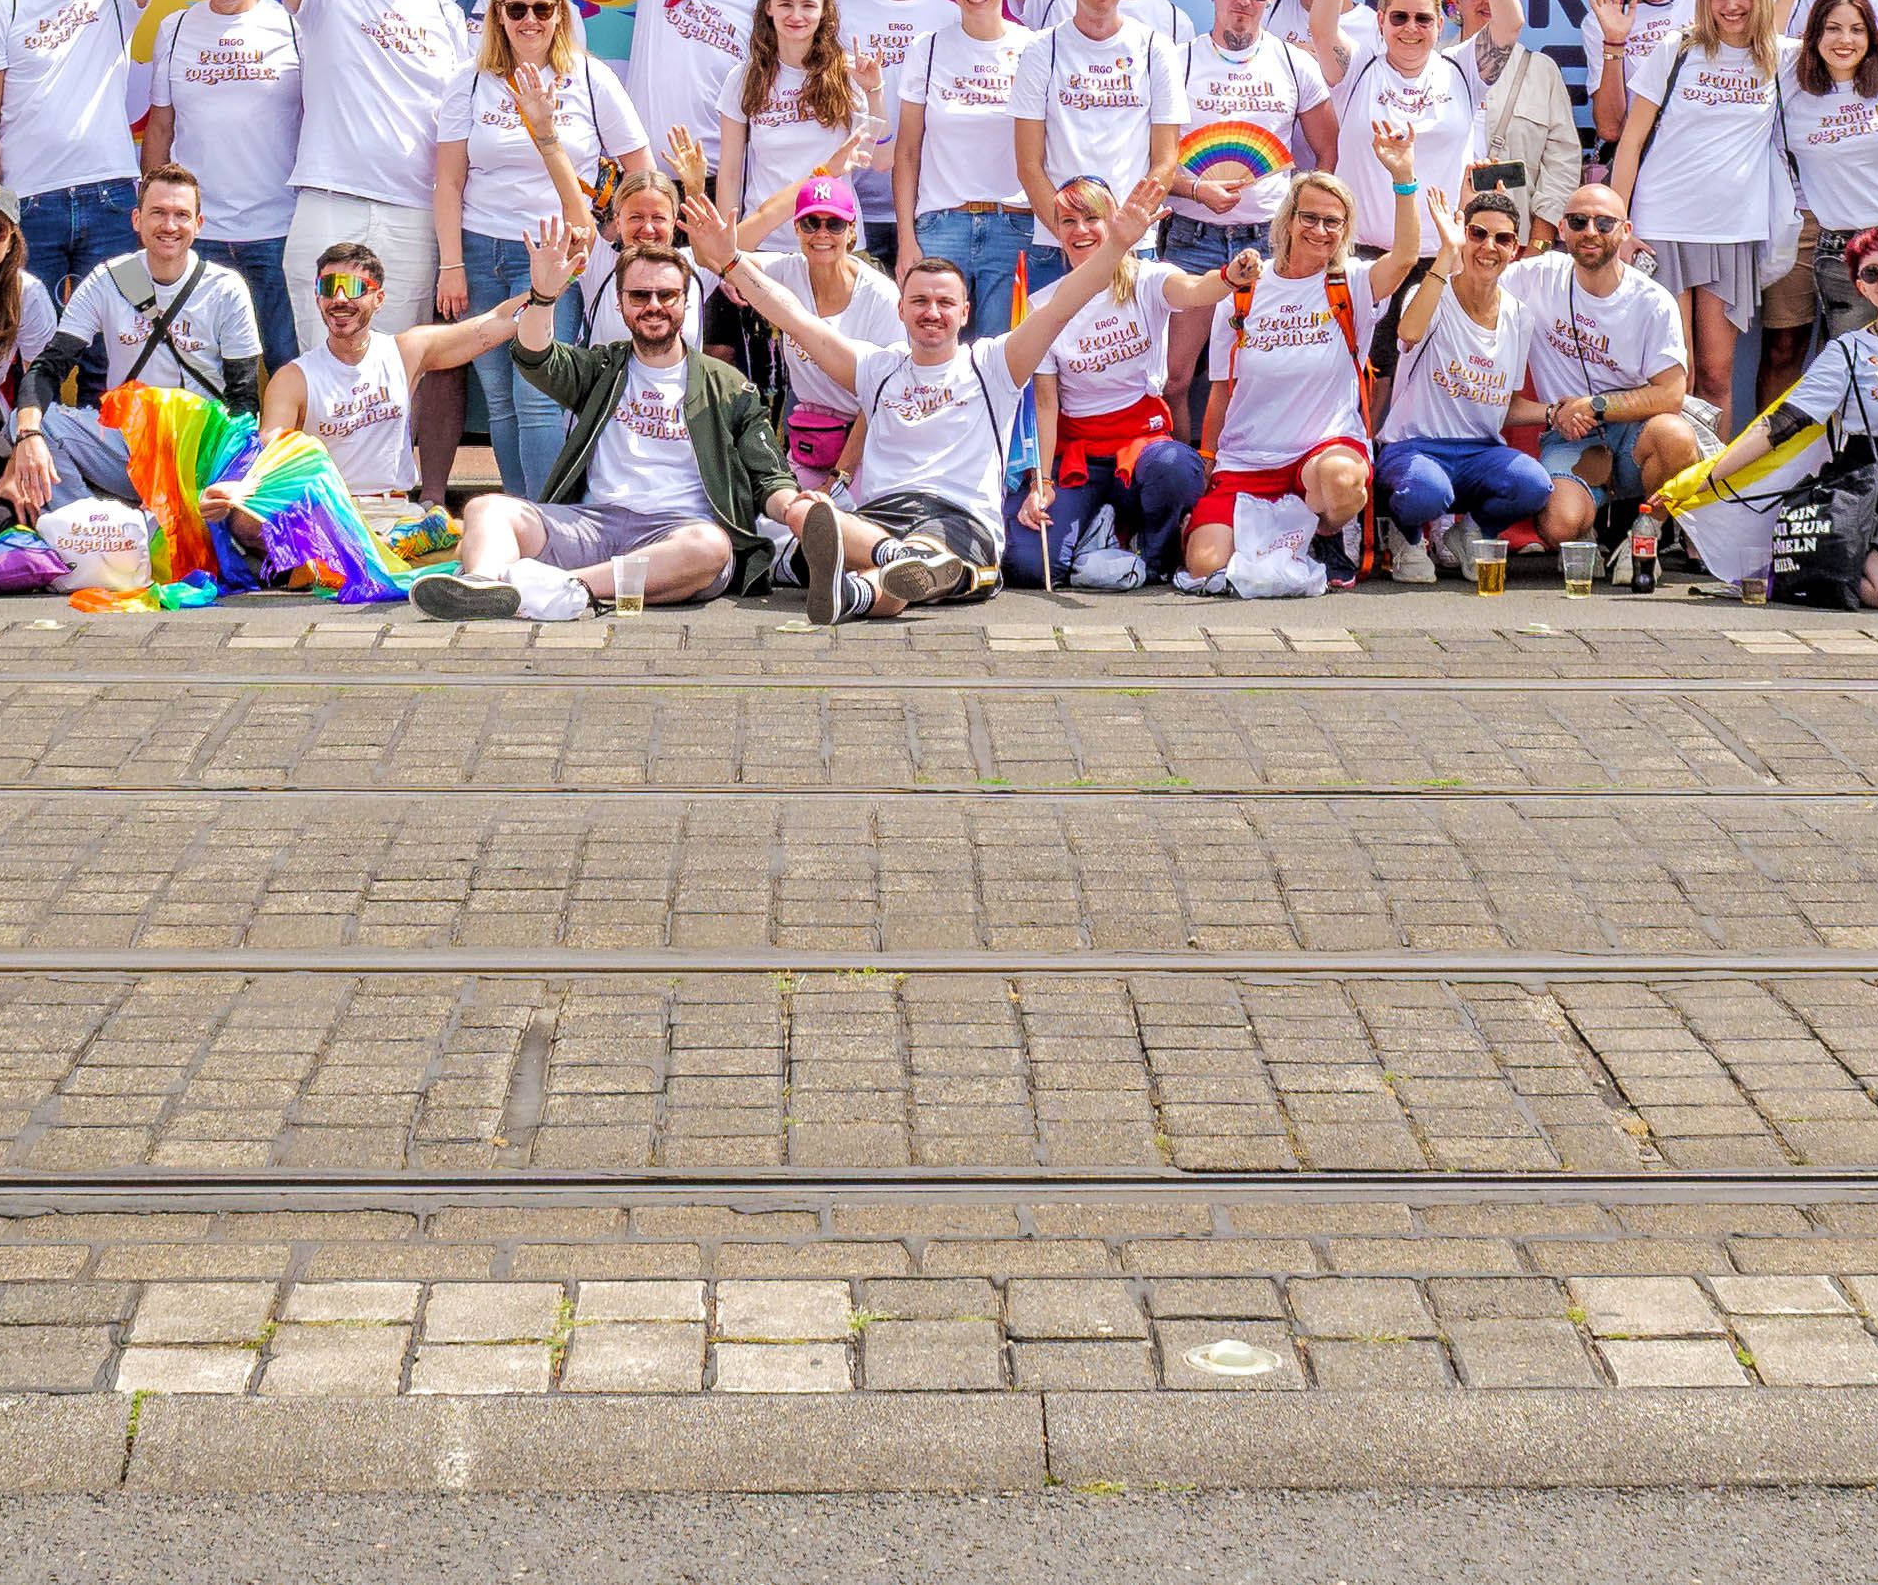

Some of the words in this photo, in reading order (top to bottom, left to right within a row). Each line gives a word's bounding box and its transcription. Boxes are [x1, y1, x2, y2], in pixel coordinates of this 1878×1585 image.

[889, 23, 913, 31] ERGO
[219, 38, 243, 46] ERGO
[974, 65, 999, 73] ERGO
[1089, 65, 1112, 73] ERGO
[1228, 72, 1252, 81] ERGO
[1839, 103, 1864, 113] ERGO
[1095, 316, 1119, 330] ERGO
[1469, 354, 1494, 367] ERGO
[642, 390, 665, 400] ERGO
